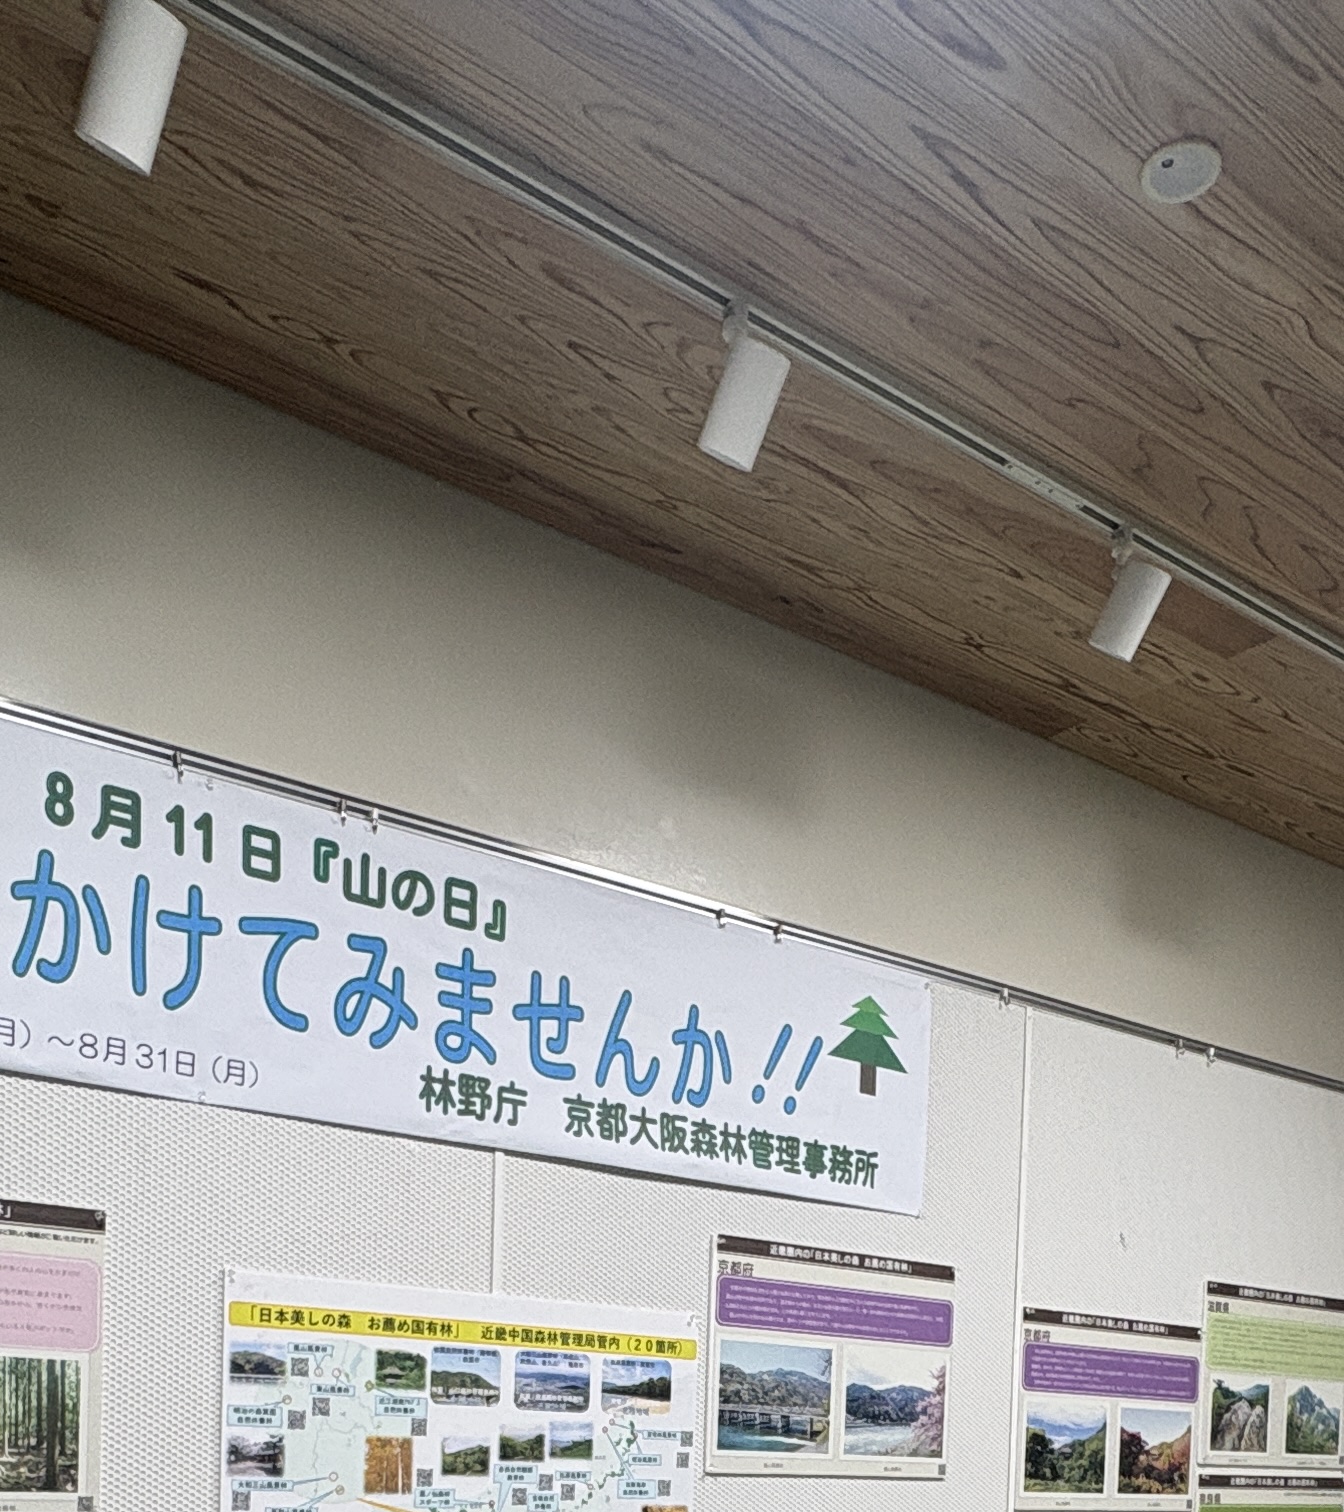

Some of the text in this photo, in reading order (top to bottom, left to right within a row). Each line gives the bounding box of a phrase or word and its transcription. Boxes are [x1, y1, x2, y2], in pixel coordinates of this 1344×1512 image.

[419, 1067, 880, 1190] 林野庁 京都大阪森林管理事務所
[717, 1260, 754, 1277] 京都府
[250, 1304, 351, 1329] 「日本美しの森
[368, 1317, 460, 1339] お薦め国有林」
